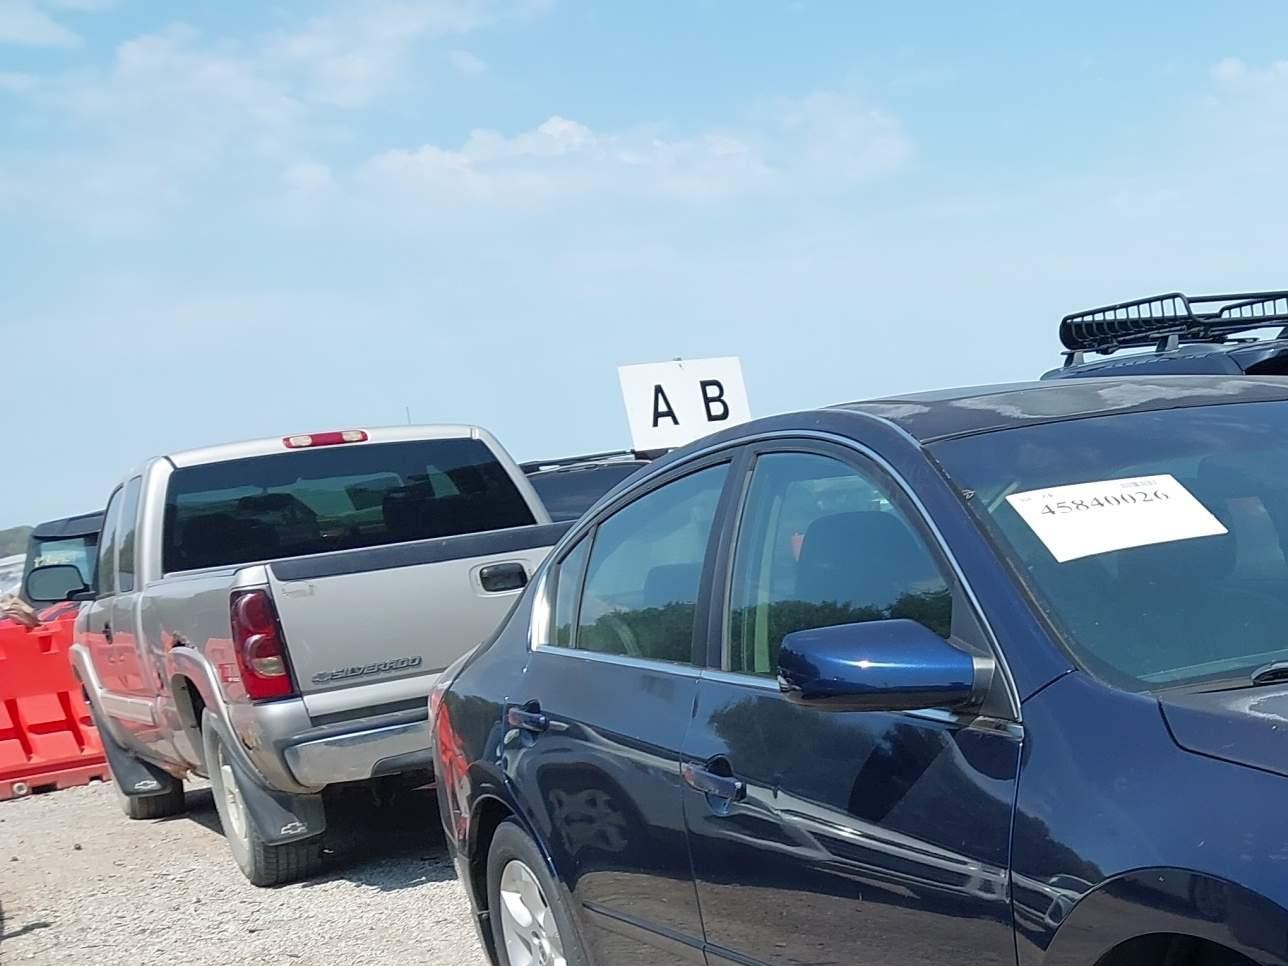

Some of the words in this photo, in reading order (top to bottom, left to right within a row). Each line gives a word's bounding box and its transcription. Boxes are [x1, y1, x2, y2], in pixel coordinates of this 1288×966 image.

[652, 384, 680, 428] A
[699, 379, 729, 422] B
[1041, 488, 1169, 515] 45840026
[327, 655, 423, 681] SILVERADO
